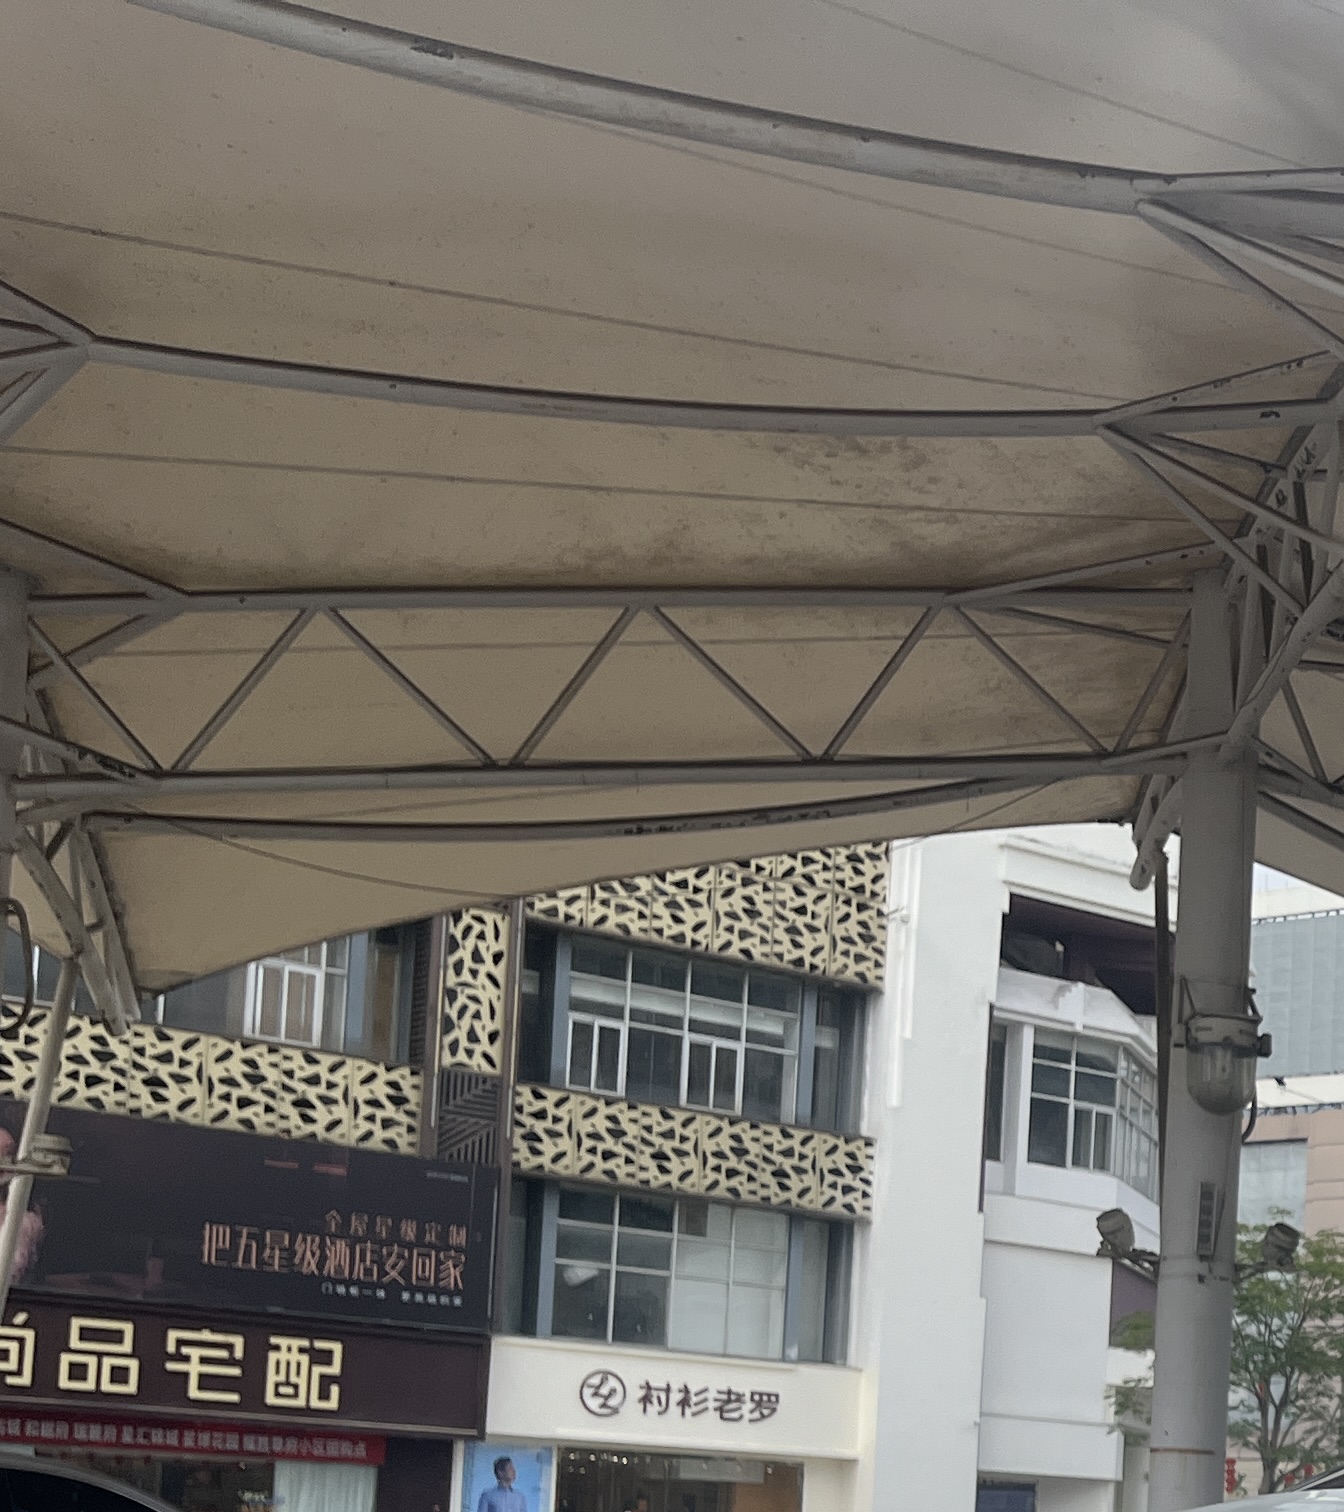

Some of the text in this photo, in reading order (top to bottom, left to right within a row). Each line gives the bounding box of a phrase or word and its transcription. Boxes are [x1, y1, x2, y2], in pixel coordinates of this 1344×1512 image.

[201, 1221, 466, 1290] 把五星级酒店安回家
